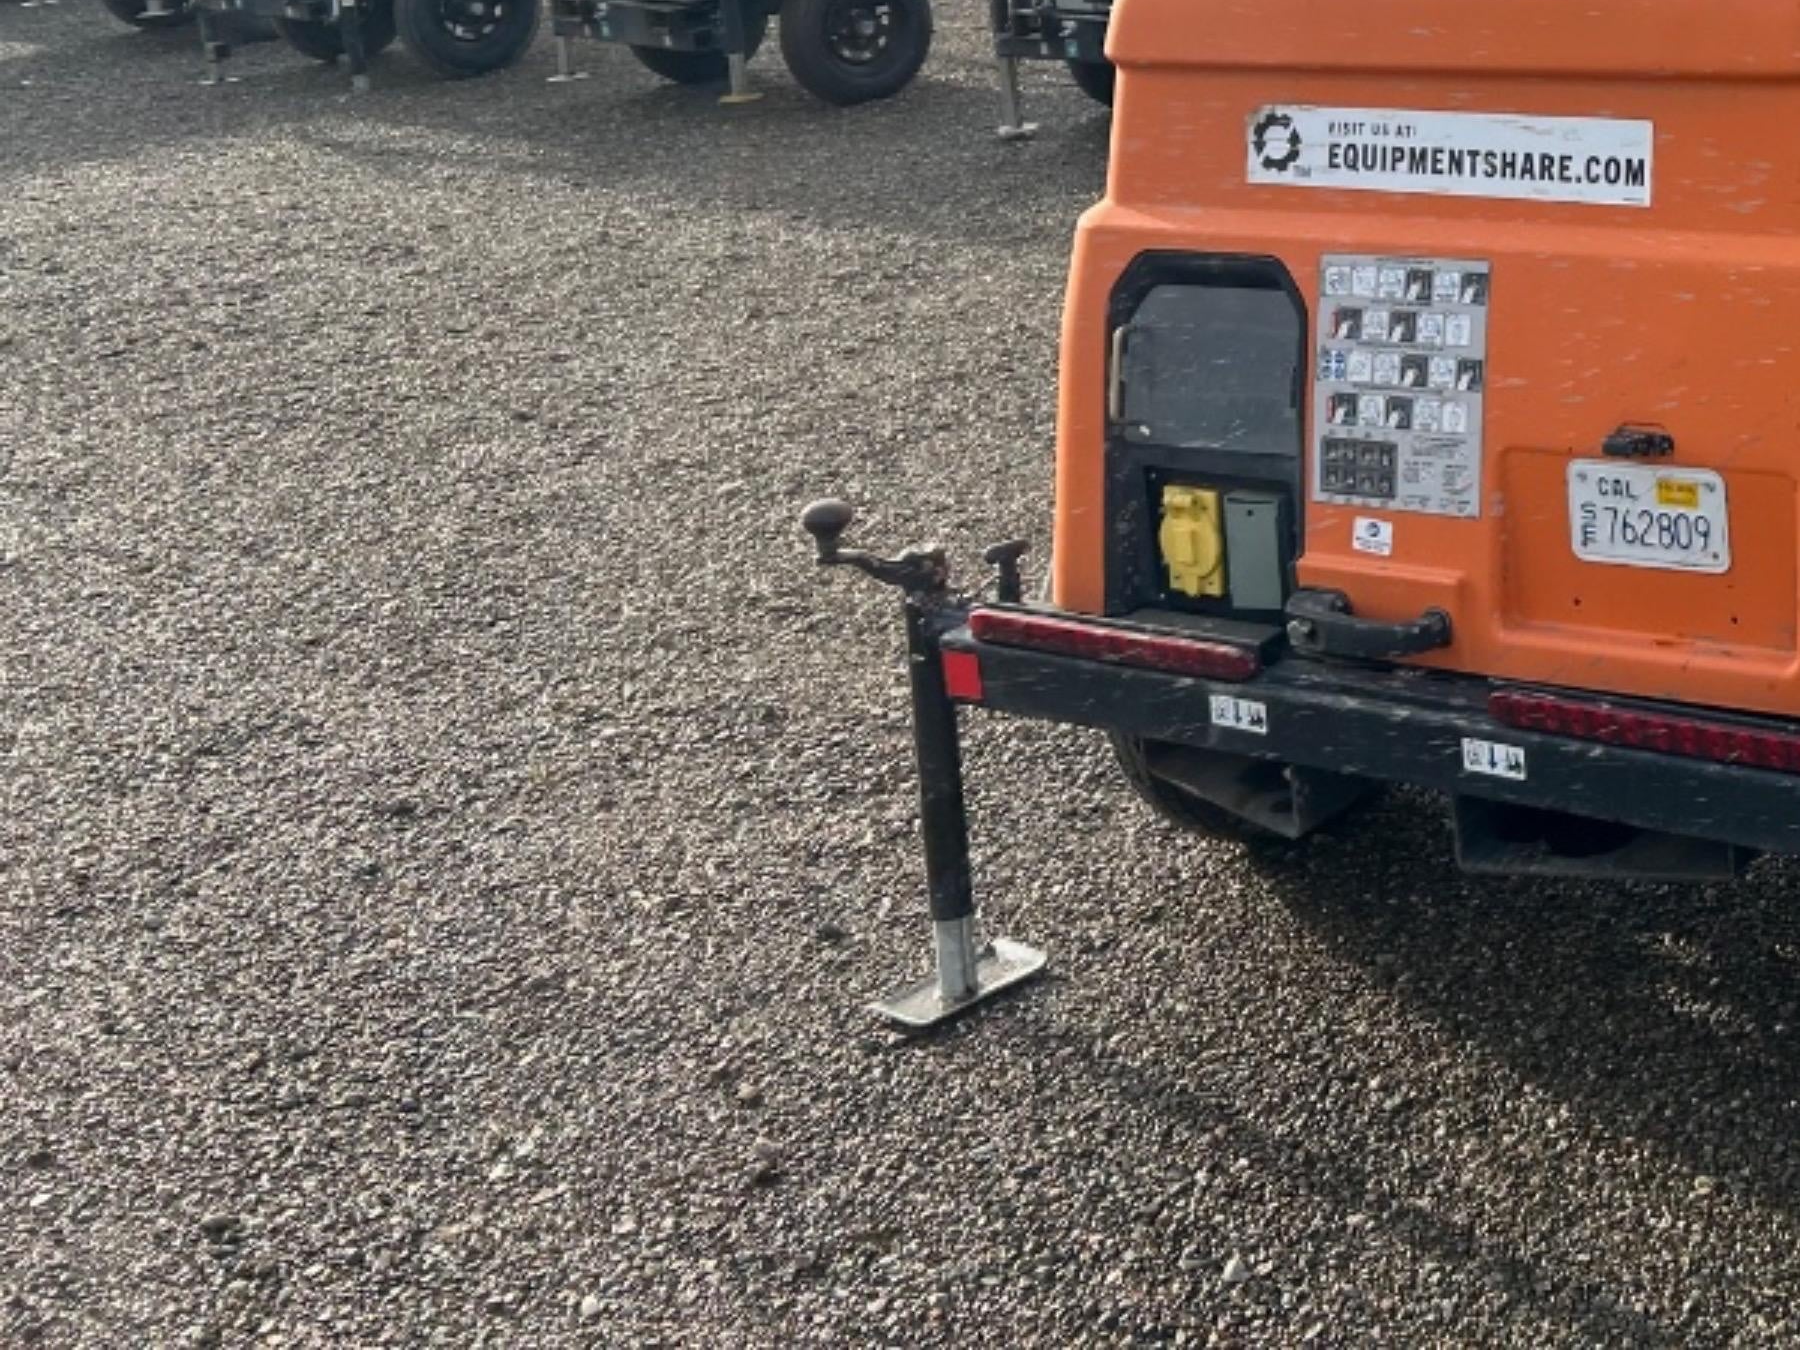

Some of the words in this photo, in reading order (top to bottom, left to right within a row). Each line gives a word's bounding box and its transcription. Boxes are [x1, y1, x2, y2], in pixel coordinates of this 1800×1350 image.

[1327, 143, 1646, 188] EQUIPMENTSHARE.COM
[1597, 476, 1639, 501] CAL
[1602, 506, 1711, 552] 762809
